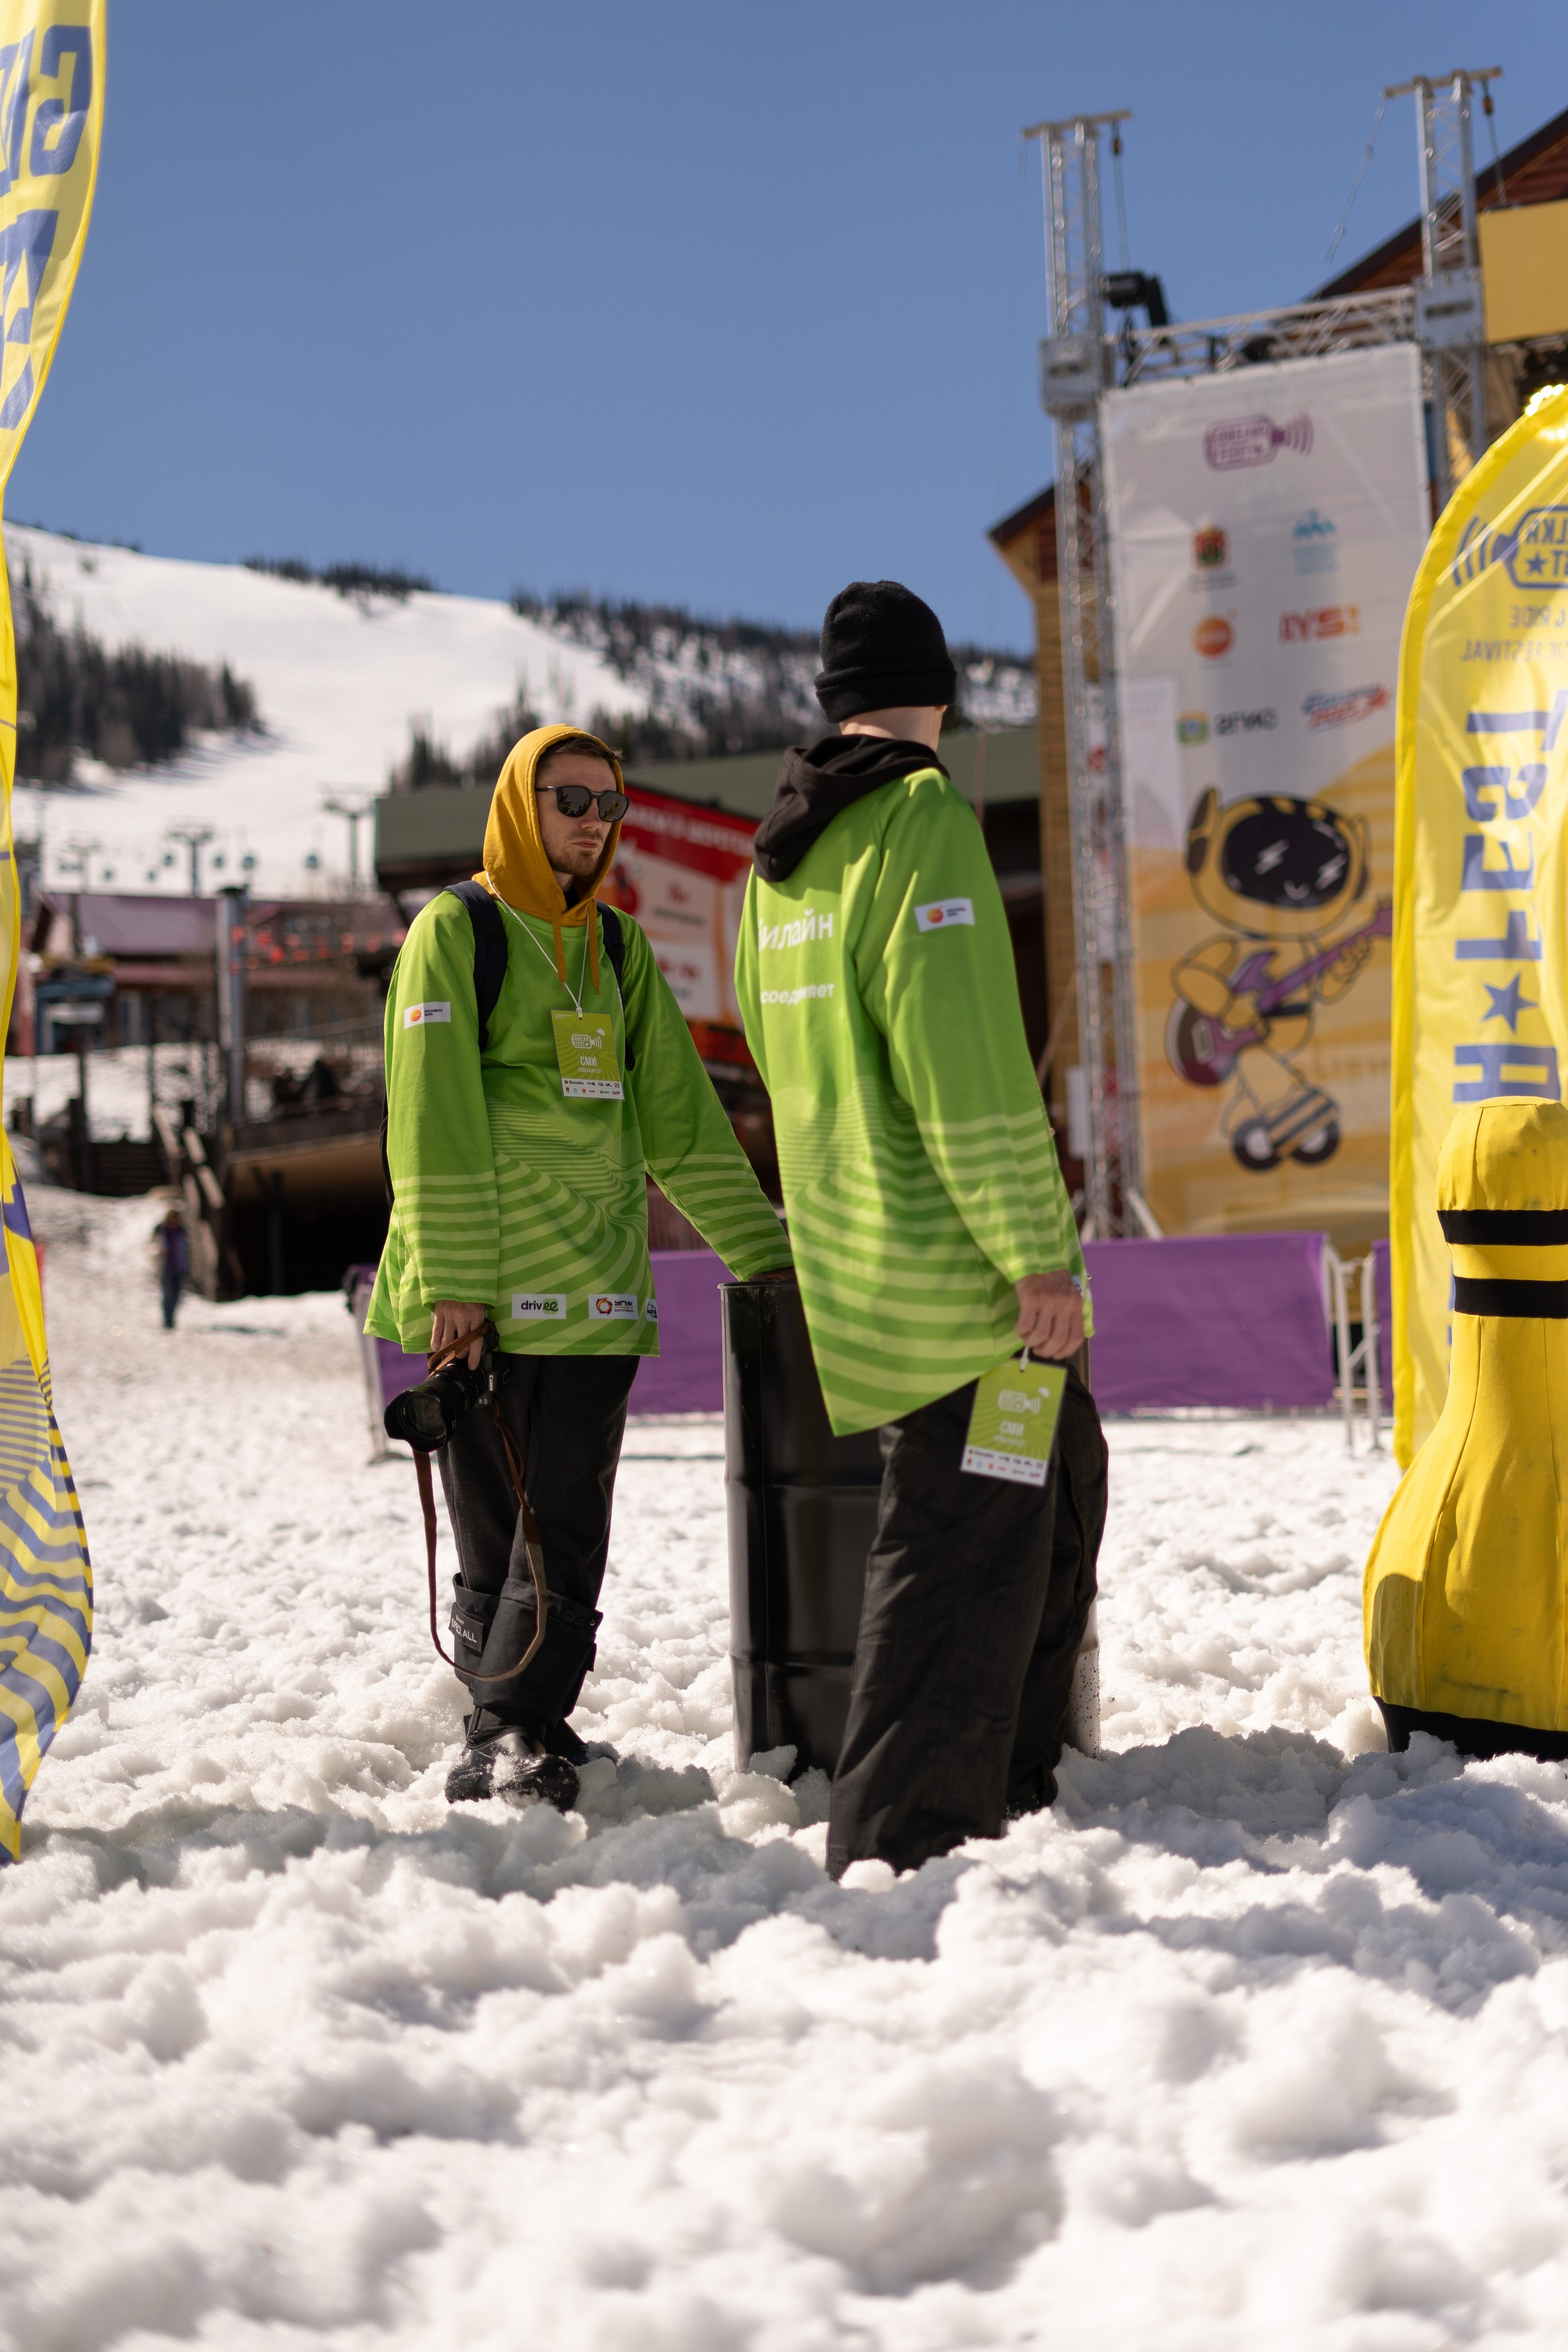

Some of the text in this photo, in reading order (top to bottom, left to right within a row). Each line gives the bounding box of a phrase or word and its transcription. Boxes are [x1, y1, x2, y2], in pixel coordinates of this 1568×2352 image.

[579, 1056, 597, 1066] СМИ
[521, 1300, 559, 1312] drivee
[1000, 1420, 1024, 1436] СМИ
